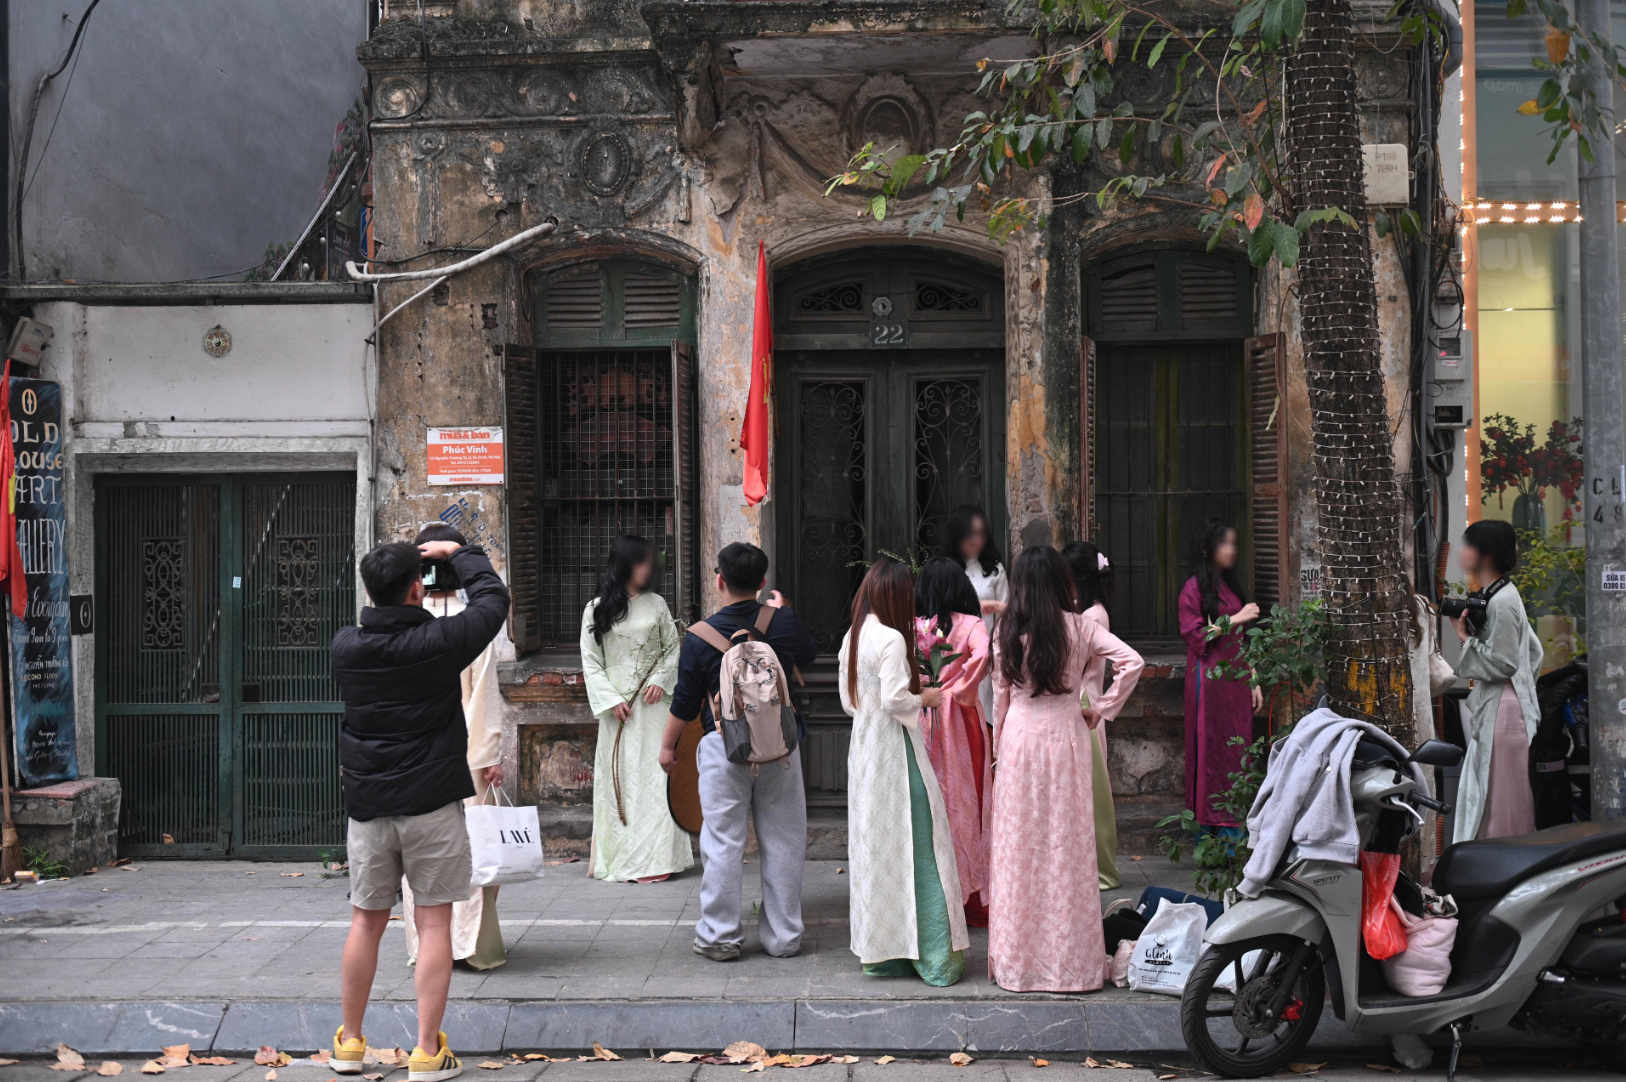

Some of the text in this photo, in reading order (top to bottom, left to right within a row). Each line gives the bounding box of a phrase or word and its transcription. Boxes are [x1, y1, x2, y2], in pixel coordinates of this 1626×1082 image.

[874, 324, 904, 344] 22
[442, 445, 465, 454] Phúc
[14, 450, 64, 471] ouse
[15, 474, 62, 505] ART
[18, 518, 67, 575] ALLERY
[1489, 579, 1505, 594] Canon
[20, 672, 59, 682] SECOND FLOOR
[1313, 875, 1341, 885] SPORTY
